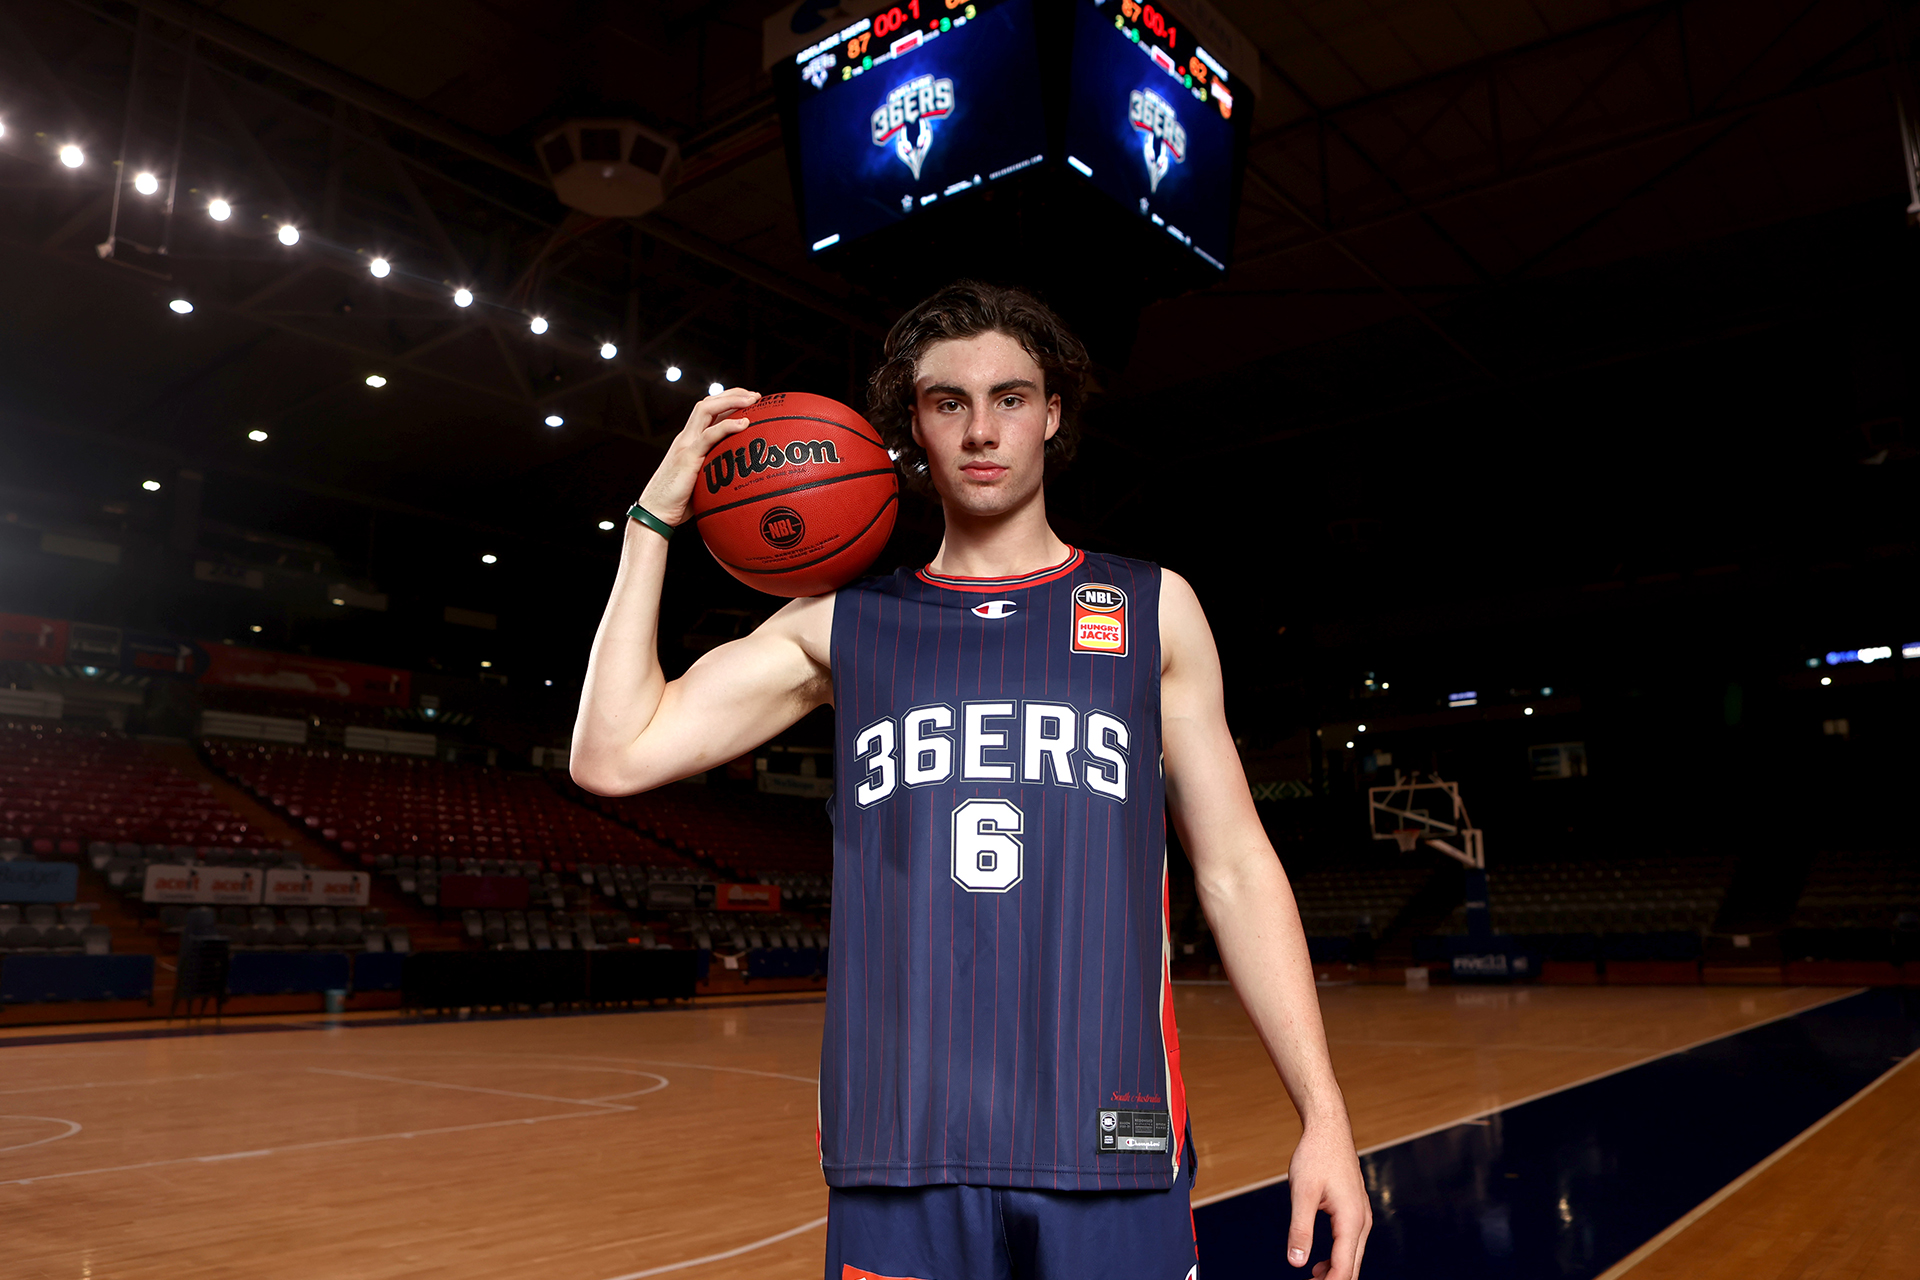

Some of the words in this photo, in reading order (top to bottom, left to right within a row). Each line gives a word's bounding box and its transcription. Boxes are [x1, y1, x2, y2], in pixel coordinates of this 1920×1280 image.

[847, 32, 871, 59] 87
[873, 80, 953, 139] 36ERS
[1130, 92, 1185, 155] 36ERS
[742, 399, 784, 413] APPROVED
[703, 437, 840, 494] Wilson
[734, 477, 764, 491] SOLUTION
[768, 518, 797, 540] NBL
[775, 545, 814, 558] BASKETBALL
[816, 534, 840, 547] LEAGUE
[789, 552, 808, 560] GAME
[809, 546, 825, 554] BALL
[1086, 591, 1114, 605] NBL
[1080, 624, 1119, 632] HUNGRY
[853, 699, 1132, 811] 36ERS
[951, 797, 1024, 894] 6
[1111, 1091, 1130, 1102] South
[1131, 1092, 1162, 1103] Australia
[1126, 1138, 1160, 1149] Champion
